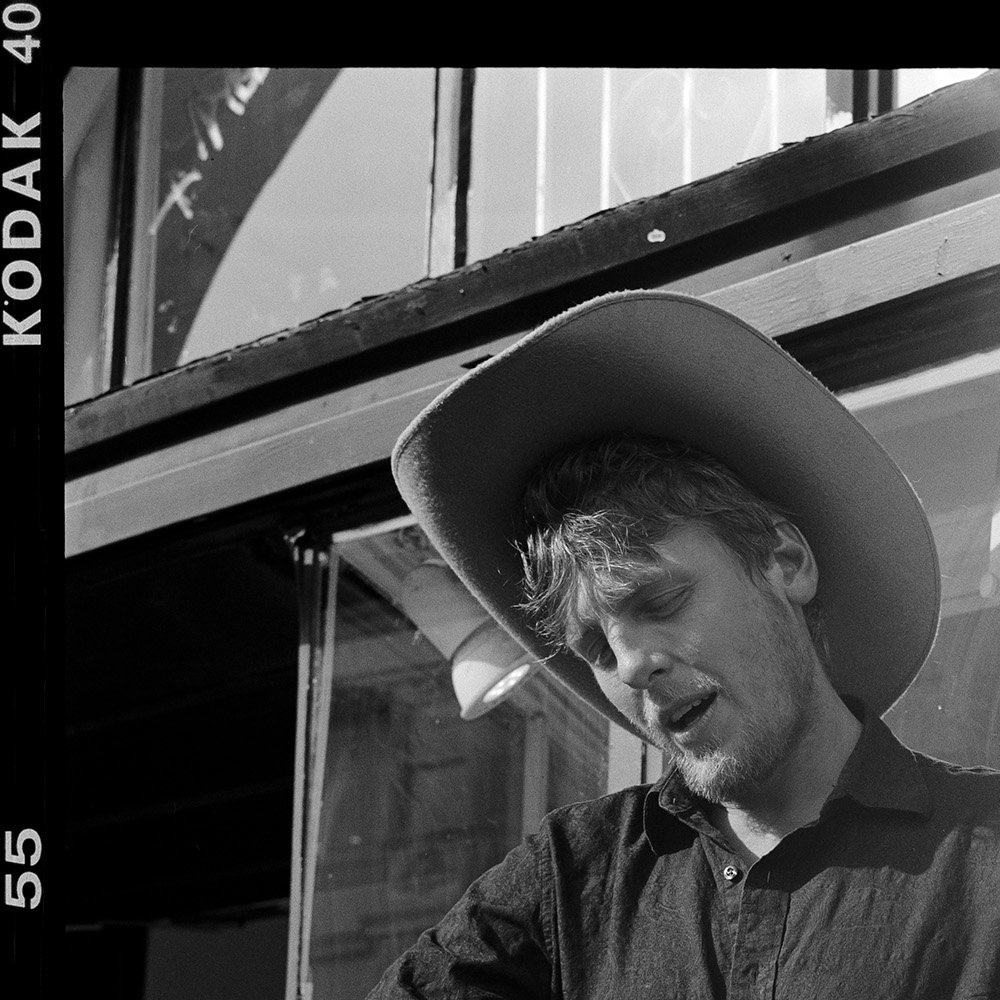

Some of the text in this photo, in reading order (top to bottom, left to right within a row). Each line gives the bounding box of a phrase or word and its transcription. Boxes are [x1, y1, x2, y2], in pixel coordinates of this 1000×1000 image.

[2, 3, 42, 345] KODAK 40
[4, 829, 43, 909] 55
